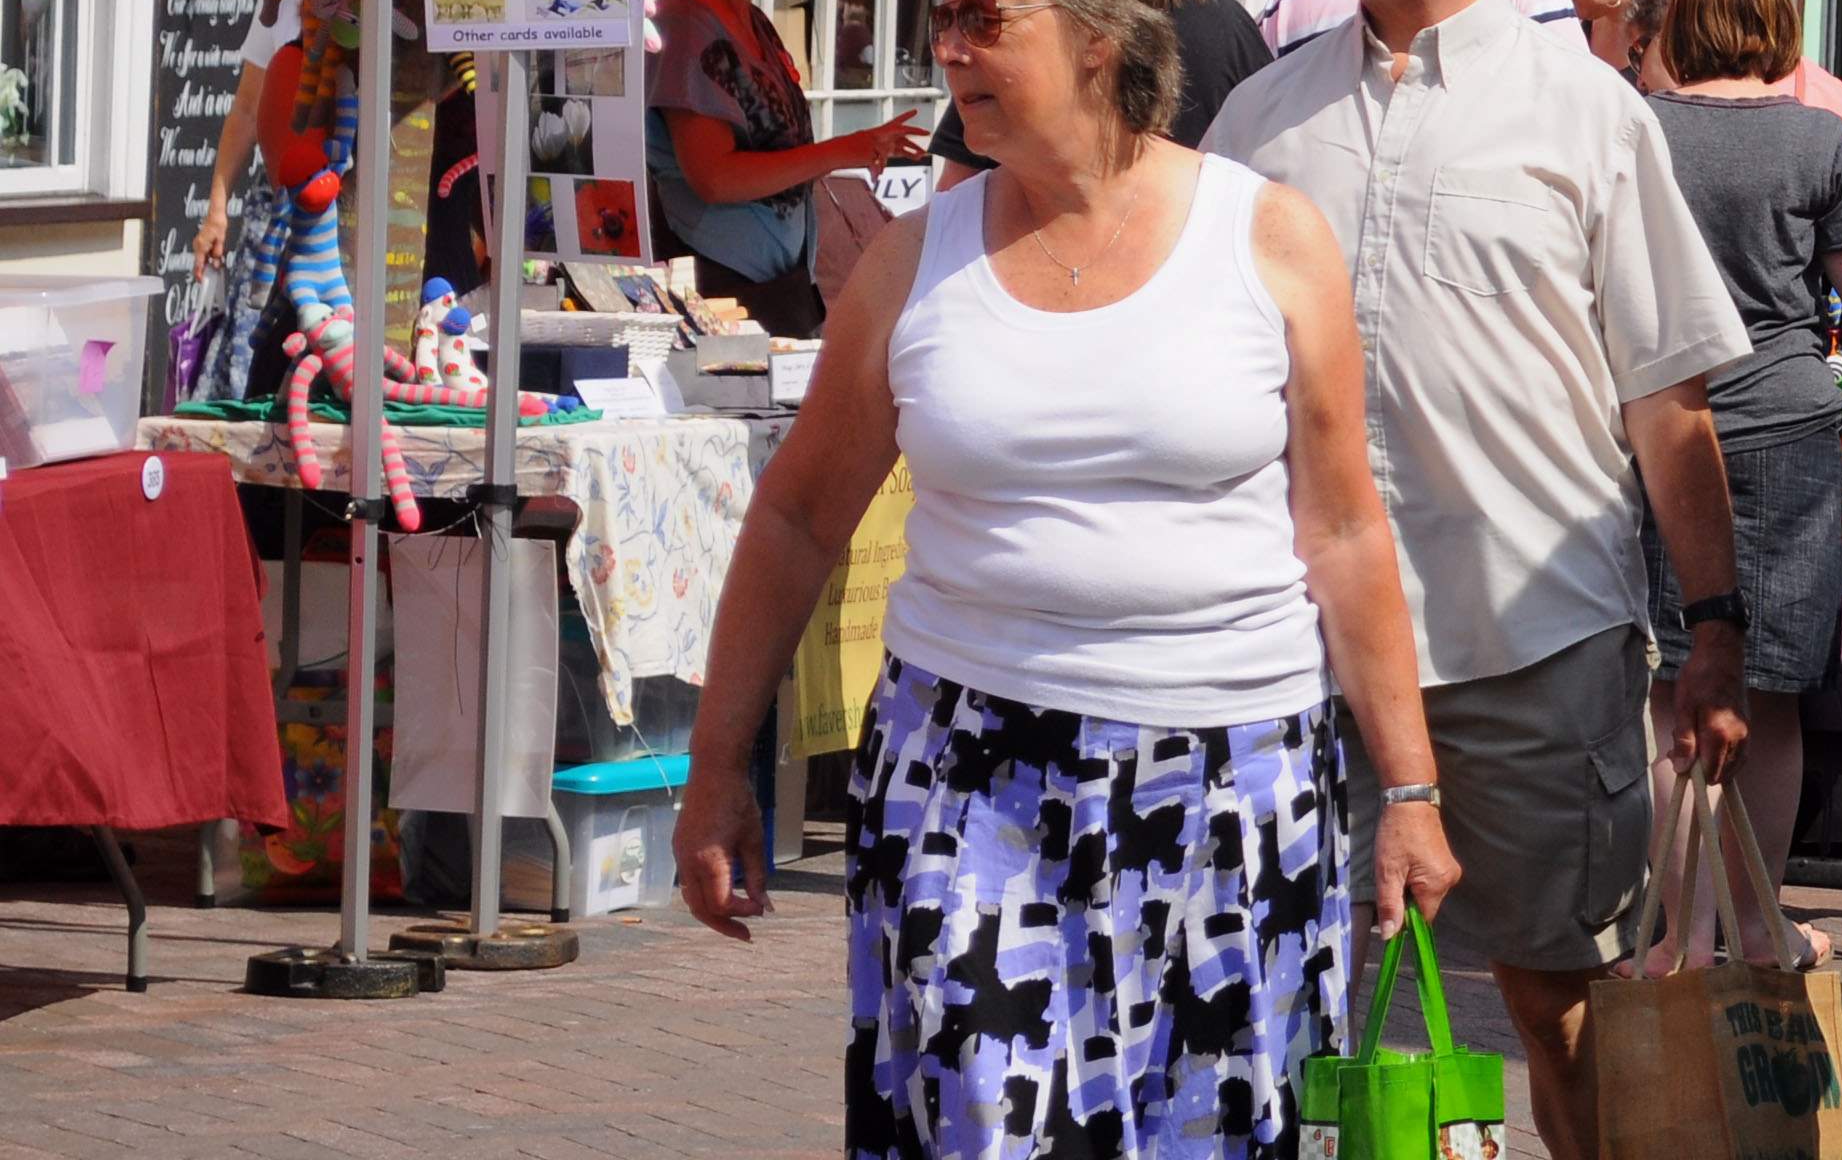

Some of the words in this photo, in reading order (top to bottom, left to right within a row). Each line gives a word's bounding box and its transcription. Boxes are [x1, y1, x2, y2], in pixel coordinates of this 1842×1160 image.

[453, 28, 494, 43] Other
[500, 28, 538, 42] cards
[544, 26, 603, 41] available
[838, 539, 873, 567] atural
[828, 580, 881, 607] Luxurious
[825, 616, 878, 646] Handmade
